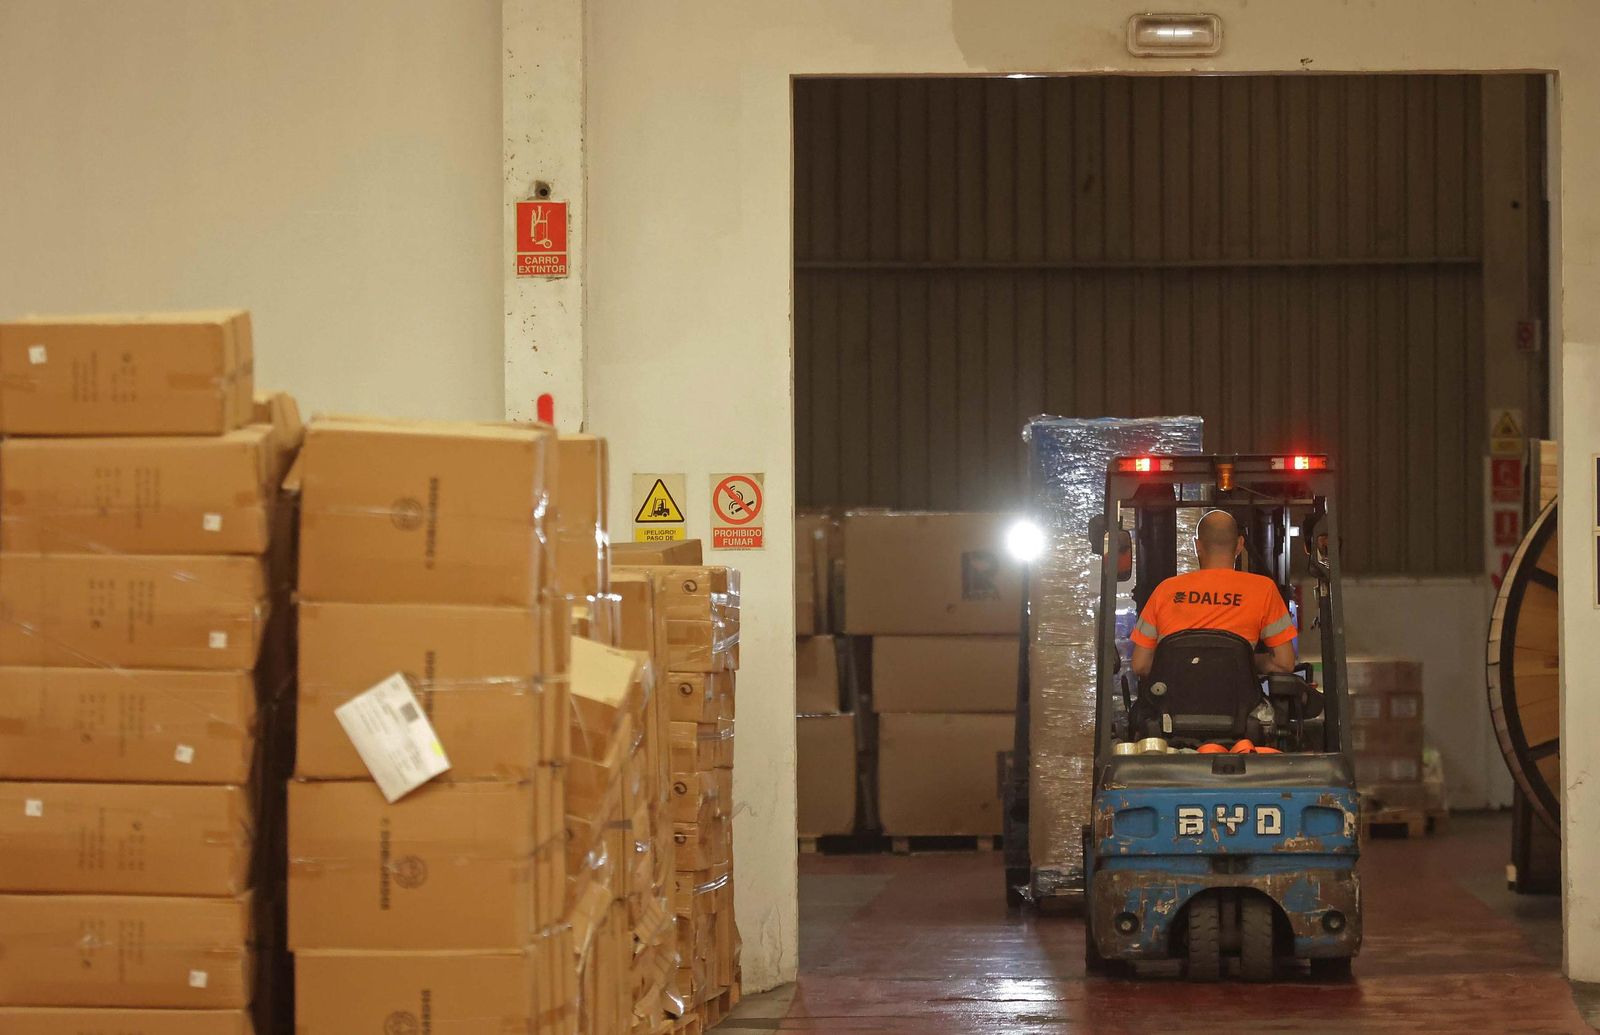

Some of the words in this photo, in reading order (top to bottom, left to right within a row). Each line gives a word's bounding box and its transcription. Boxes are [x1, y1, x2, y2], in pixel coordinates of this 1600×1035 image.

[525, 256, 559, 265] CARRO
[518, 265, 566, 274] EXTINTOR
[714, 529, 762, 537] PROHIBIDO
[723, 538, 753, 546] FUMAR
[1188, 591, 1242, 607] DALSE
[1179, 807, 1281, 835] BYD
